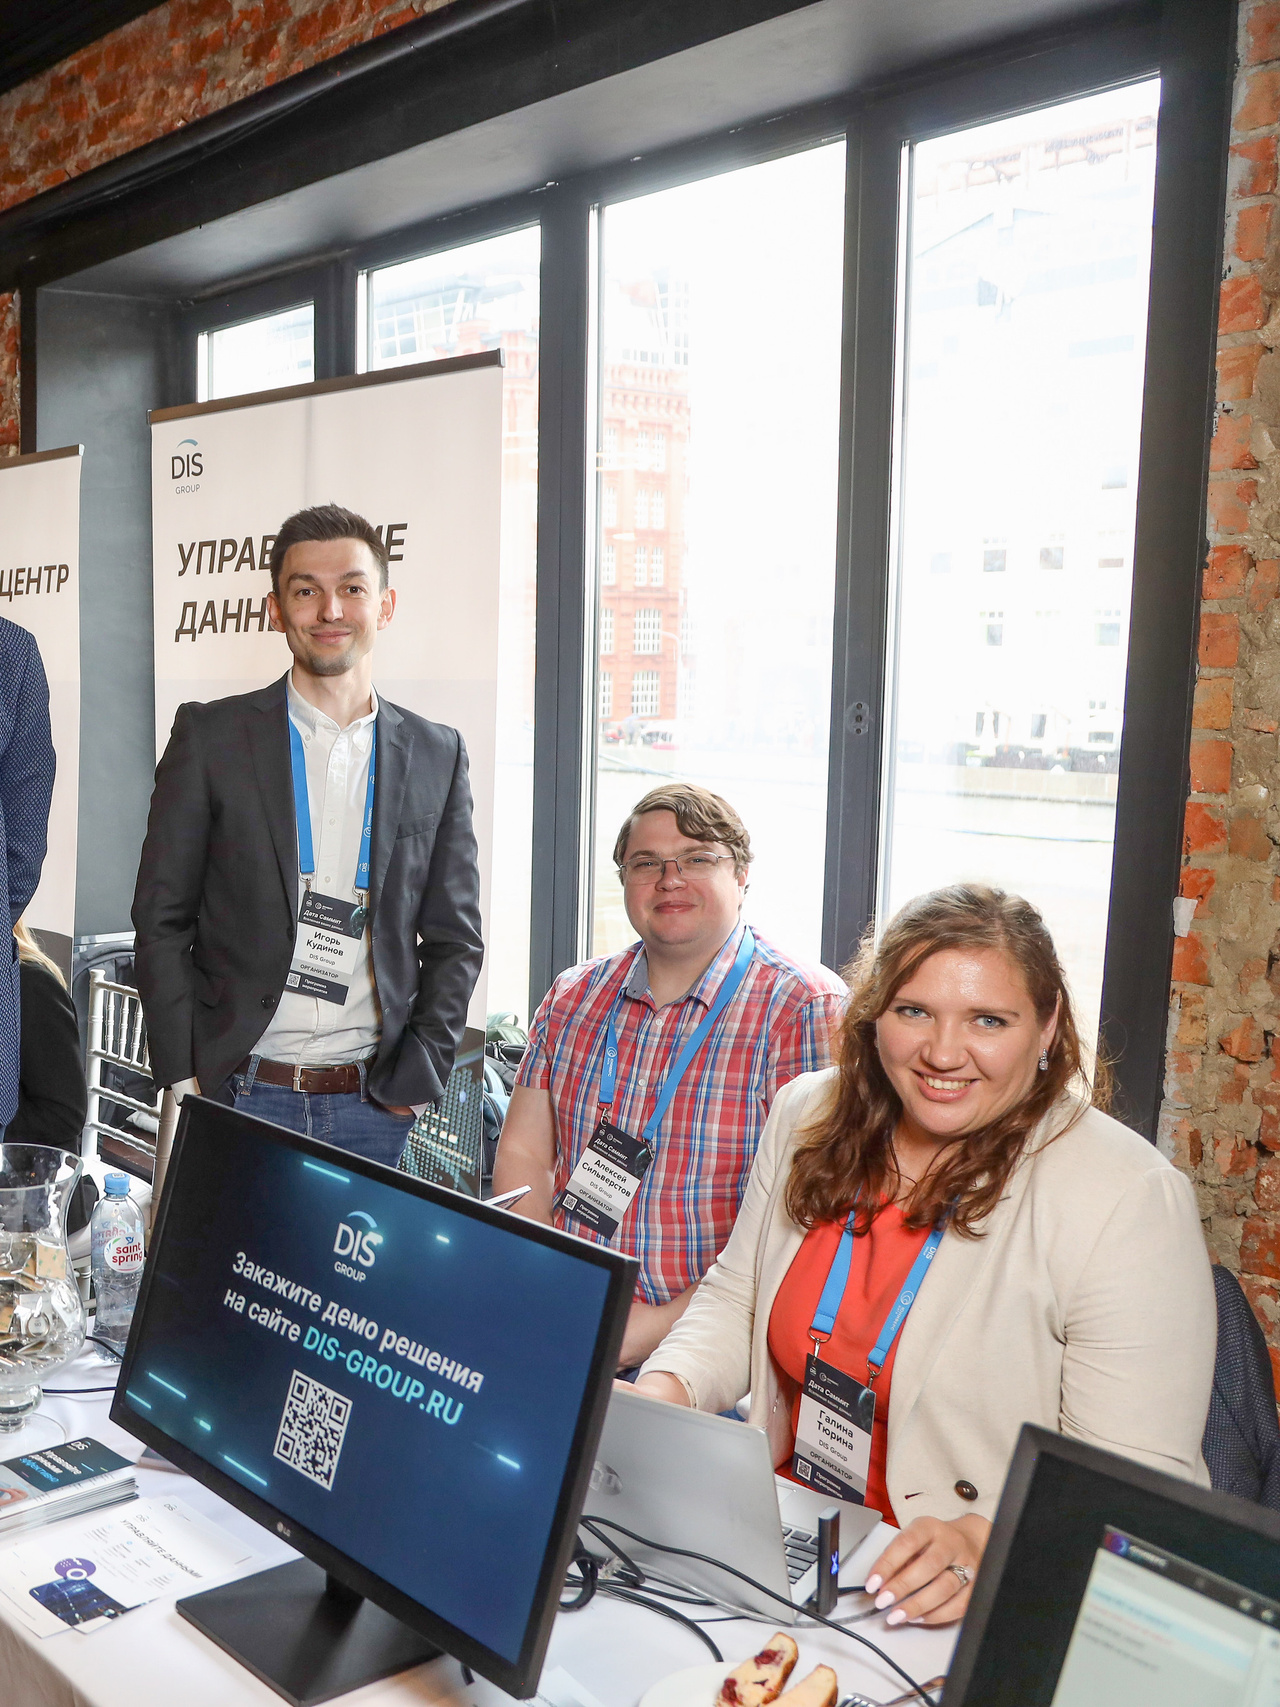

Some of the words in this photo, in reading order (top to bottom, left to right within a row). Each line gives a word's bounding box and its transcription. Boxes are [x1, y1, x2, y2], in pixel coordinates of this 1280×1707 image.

[171, 452, 204, 480] DIS
[176, 484, 200, 494] GROUP
[174, 597, 273, 642] ДАНН
[304, 909, 318, 918] Дата
[320, 914, 342, 924] Саммит
[306, 939, 344, 956] Кудинов
[314, 932, 340, 946] Игорь
[300, 964, 338, 978] ОРГАНИЗАТОР
[320, 956, 335, 966] Group
[594, 1138, 608, 1149] Дата
[608, 1145, 628, 1160] Саммит
[582, 1162, 631, 1197] Сильверстов
[594, 1160, 626, 1183] Алексей
[579, 1188, 612, 1212] ОРГАНИЗАТОР
[590, 1181, 598, 1190] DIS
[598, 1186, 612, 1198] Group
[116, 1242, 141, 1254] saint
[334, 1222, 377, 1268] DIS
[926, 1246, 936, 1260] DIS
[112, 1251, 142, 1266] spring
[334, 1261, 366, 1283] GROUP
[232, 1251, 322, 1313] Закажите
[321, 1300, 378, 1341] демо
[378, 1328, 484, 1394] решения
[224, 1288, 246, 1314] на
[248, 1306, 301, 1342] сайте
[303, 1326, 464, 1425] DIS-GROUP.RU
[808, 1380, 824, 1393] Дата
[824, 1386, 850, 1408] Саммит
[816, 1420, 854, 1450] Тюрина
[819, 1410, 854, 1438] Галина
[818, 1440, 829, 1450] DIS
[830, 1446, 848, 1462] Group
[810, 1450, 852, 1480] ОРГАНИЗАТОР
[120, 1519, 166, 1554] УПРАВЛЯЙТЕ
[162, 1549, 202, 1578] ДАННЫМИ
